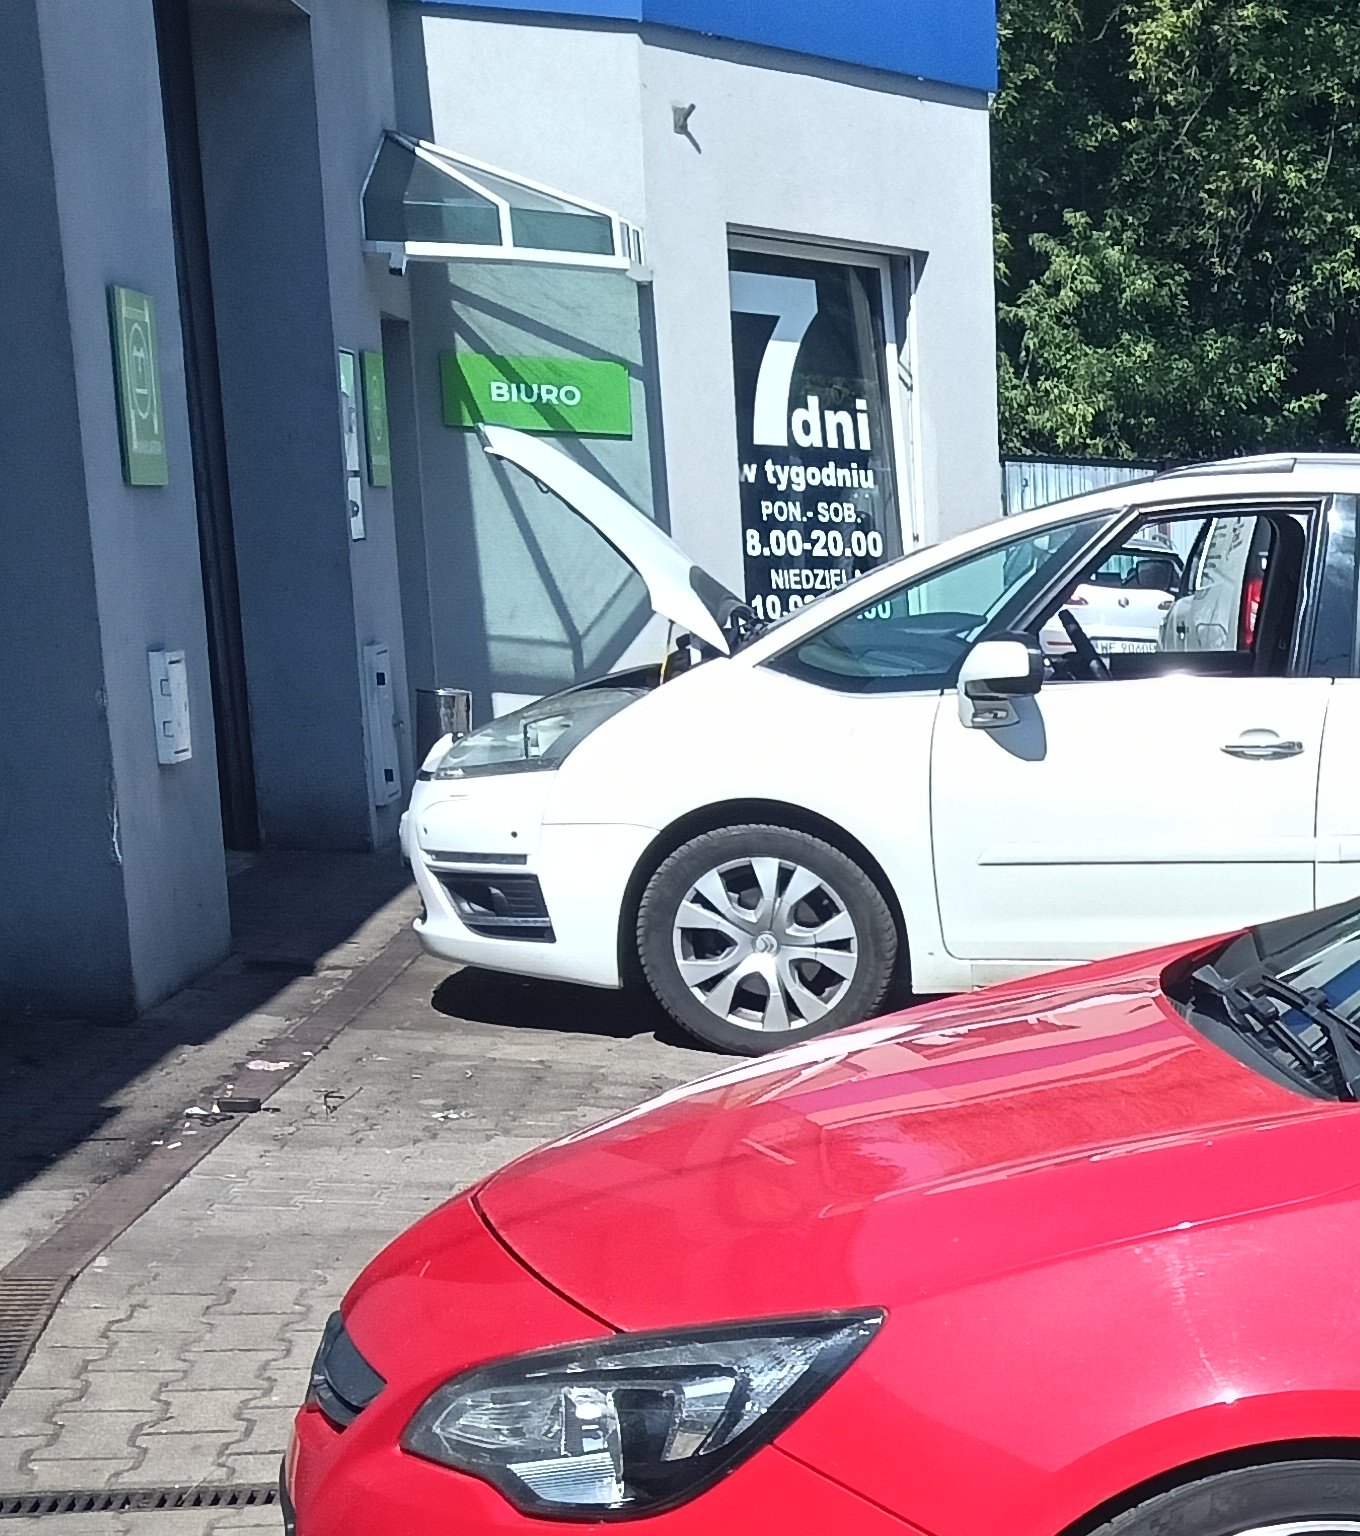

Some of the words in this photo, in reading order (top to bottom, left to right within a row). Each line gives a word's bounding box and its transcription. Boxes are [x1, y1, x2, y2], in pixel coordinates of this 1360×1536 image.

[729, 270, 819, 446] 7
[791, 395, 872, 450] dni
[490, 381, 582, 406] BIURO
[764, 458, 875, 491] tygodniu
[817, 501, 862, 524] SOB.
[745, 528, 883, 557] 8.00-20.00
